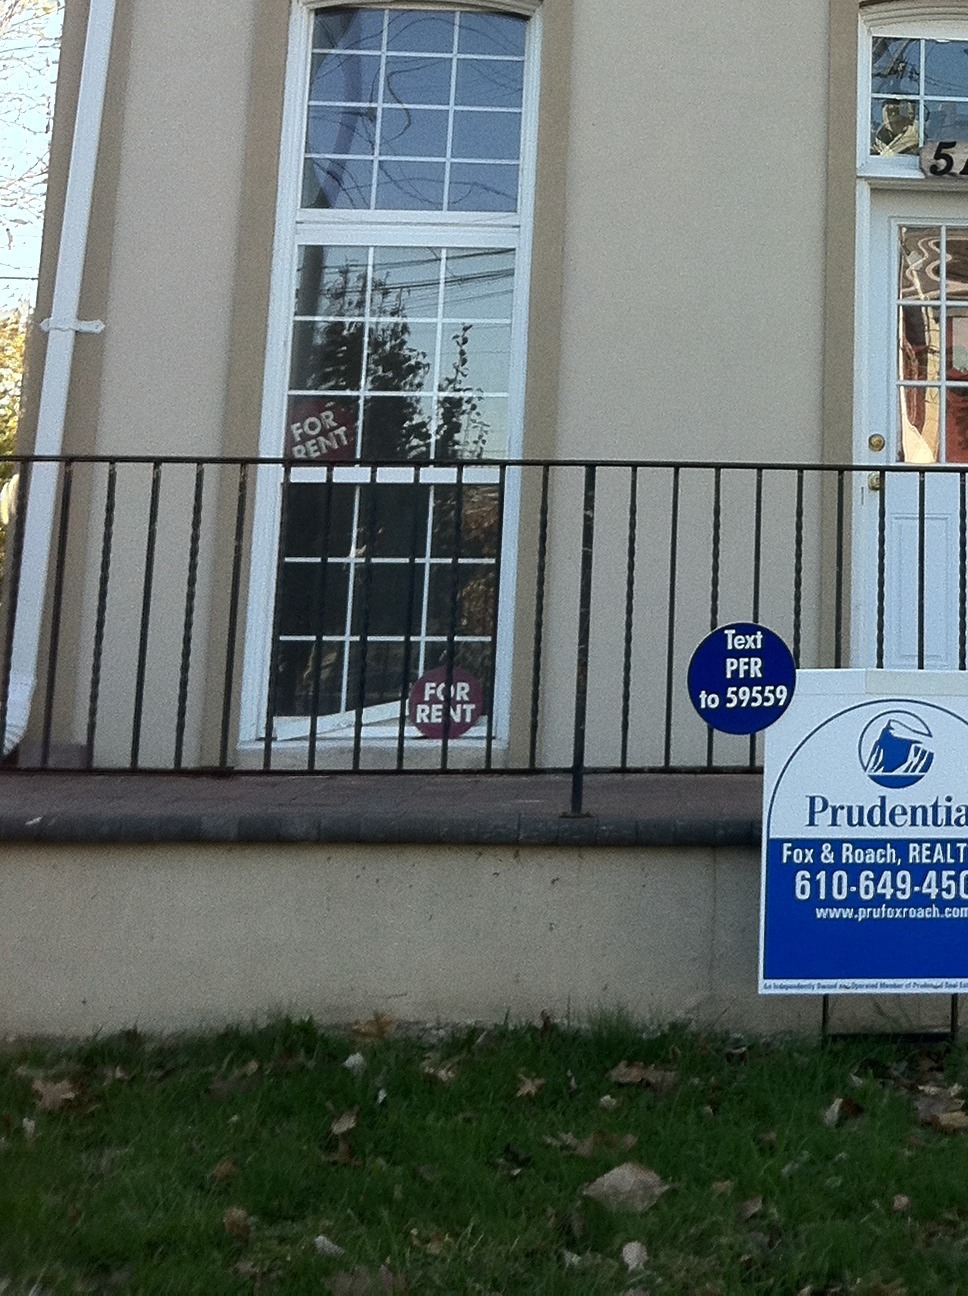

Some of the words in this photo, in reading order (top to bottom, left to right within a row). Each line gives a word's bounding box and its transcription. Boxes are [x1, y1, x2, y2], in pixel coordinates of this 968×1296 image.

[290, 410, 338, 442] FOR
[292, 426, 348, 458] RENT
[724, 629, 763, 650] Text
[725, 657, 763, 678] PFR
[424, 682, 470, 701] FOR
[699, 690, 720, 709] to
[726, 685, 788, 708] 59559
[416, 704, 476, 723] RENT
[782, 843, 814, 864] Fox
[820, 843, 835, 864] &
[841, 843, 902, 866] Roach,
